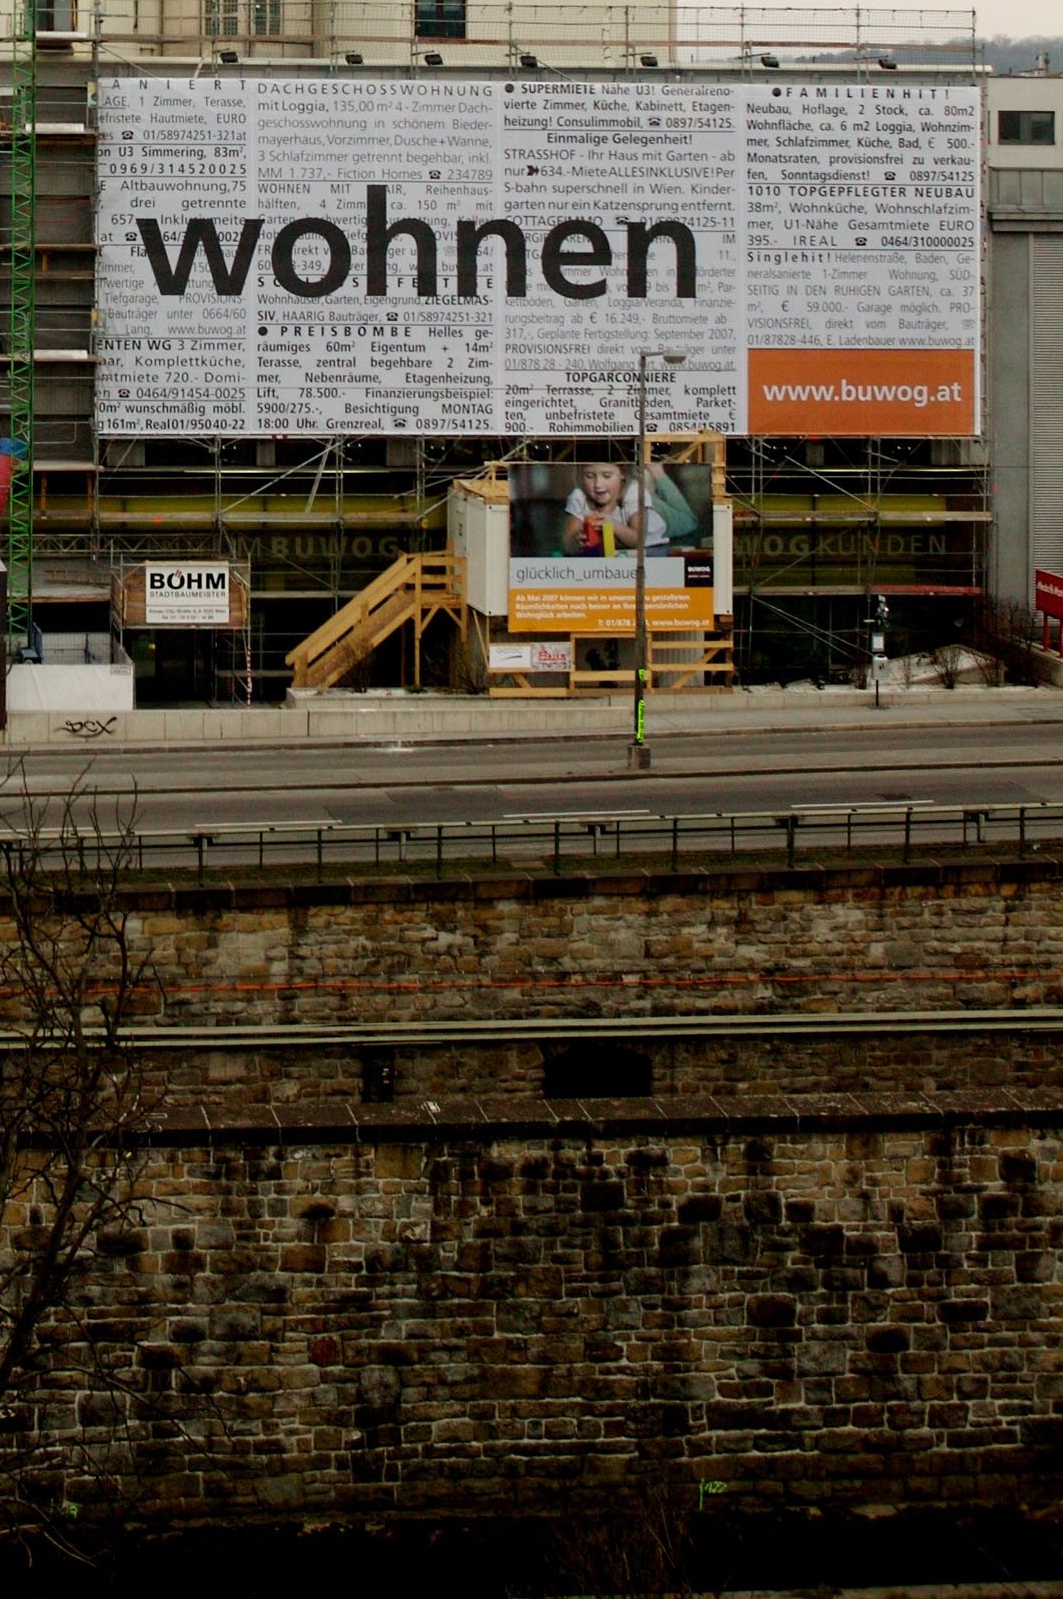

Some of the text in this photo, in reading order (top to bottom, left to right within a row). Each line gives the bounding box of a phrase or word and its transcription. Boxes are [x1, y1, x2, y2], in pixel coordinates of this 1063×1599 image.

[258, 84, 492, 96] DACHGESCHOSSWOHNUNG
[786, 88, 948, 99] FAMILIENHIT!
[504, 100, 734, 115] vierte Zimmer, Küche, Kabinett, Etagen-
[747, 103, 974, 118] Neubau, Hoflage, 2 Stock, ca. 80m2
[547, 133, 692, 148] Einmalige Gelegenheit!
[118, 146, 133, 157] U3
[142, 146, 206, 160] Simmering,
[747, 153, 975, 168] Monatsraten, provisionsfrei zu verkau-
[748, 185, 974, 198] 1010 TOPGEPFLEGTER NEUBAU
[138, 185, 697, 298] wohnen
[747, 252, 830, 266] Singlehit!
[257, 357, 493, 371] Terasse, zentral begehbare 2 Zim-
[257, 388, 495, 402] Lift, 78.500.- Finanzierungsbeispiel:
[762, 379, 961, 407] www.buwog.at
[257, 418, 289, 429] 18:00
[297, 418, 319, 429] Uhr.
[326, 418, 384, 431] Grenzreal,
[150, 569, 225, 589] BÖHM
[516, 566, 645, 583] glücklich_umbaue
[150, 590, 226, 598] STADTBAUMEISTER
